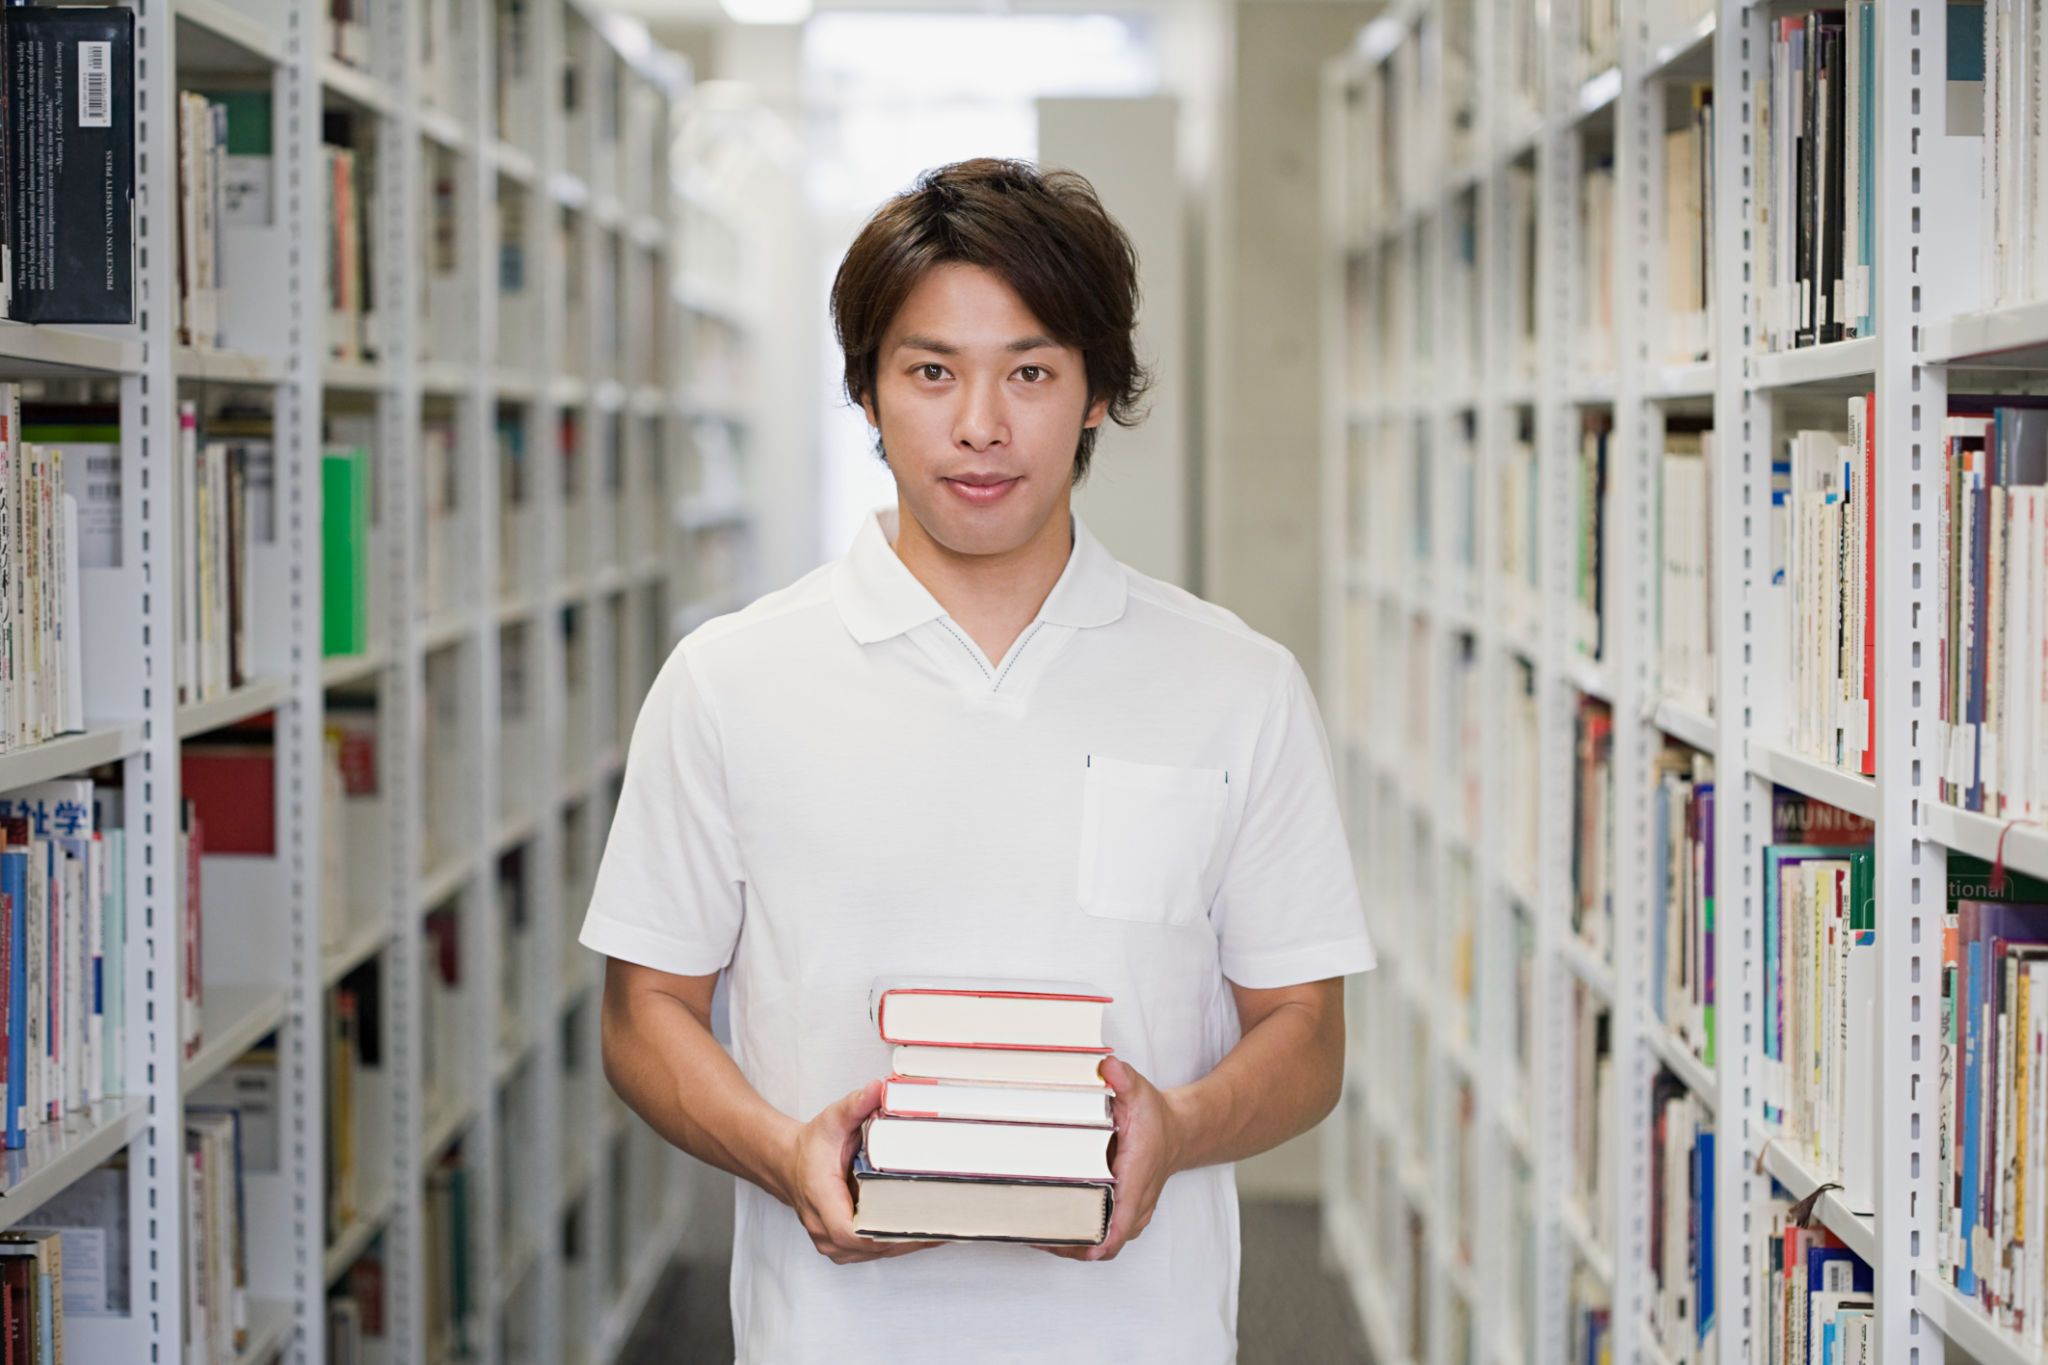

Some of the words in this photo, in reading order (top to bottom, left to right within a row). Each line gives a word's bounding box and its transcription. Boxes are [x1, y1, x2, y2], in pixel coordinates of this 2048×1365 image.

[104, 150, 113, 177] PRESS
[105, 178, 113, 234] UNIVERSITY
[106, 236, 114, 290] PRINCETON
